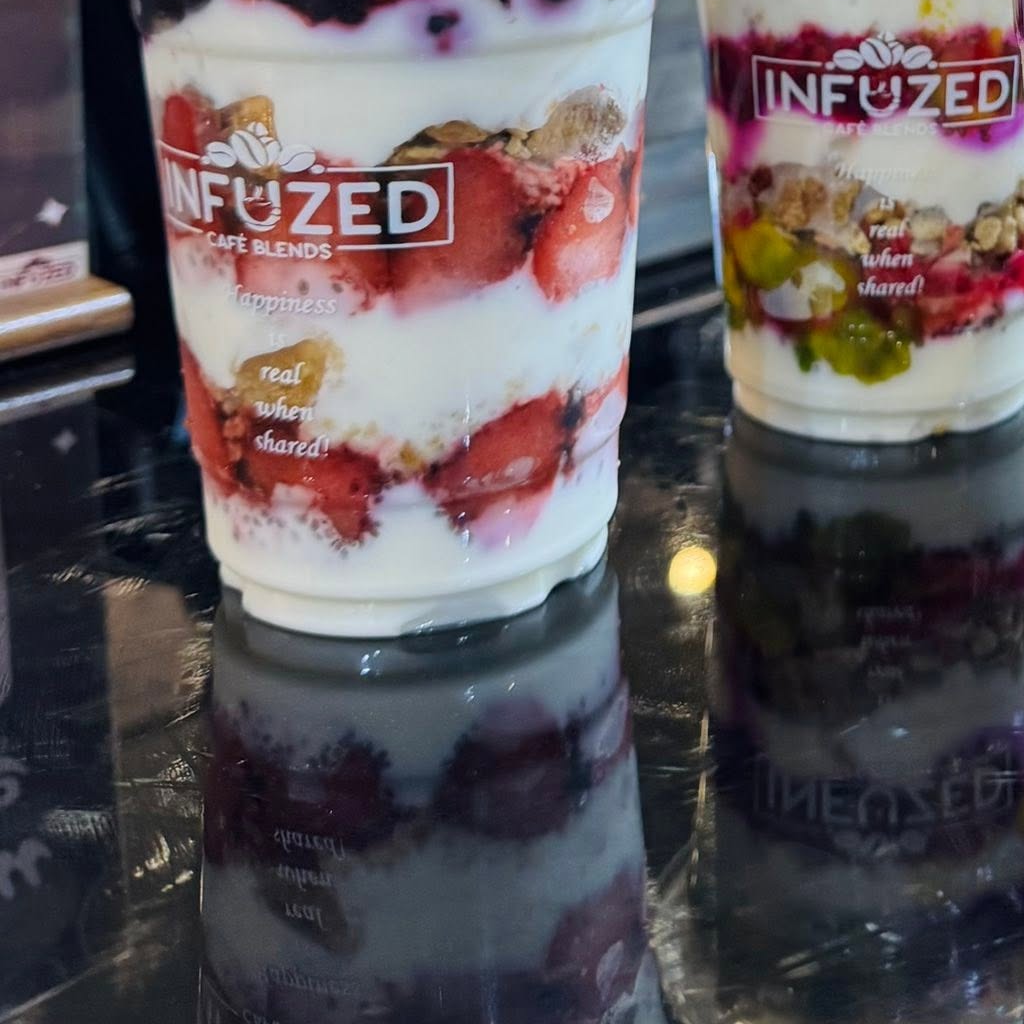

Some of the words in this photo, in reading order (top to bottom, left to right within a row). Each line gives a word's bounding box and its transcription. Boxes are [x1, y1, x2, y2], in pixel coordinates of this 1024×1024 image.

[765, 68, 1011, 117] INFUZED
[164, 157, 441, 236] INFUZED
[868, 220, 907, 238] real
[206, 231, 248, 253] CAFÉ
[252, 239, 333, 261] BLENDS
[861, 247, 913, 268] when
[226, 284, 338, 316] Happiness
[857, 275, 925, 297] shared!
[260, 362, 306, 385] real
[254, 396, 314, 422] when
[255, 429, 330, 459] shared!
